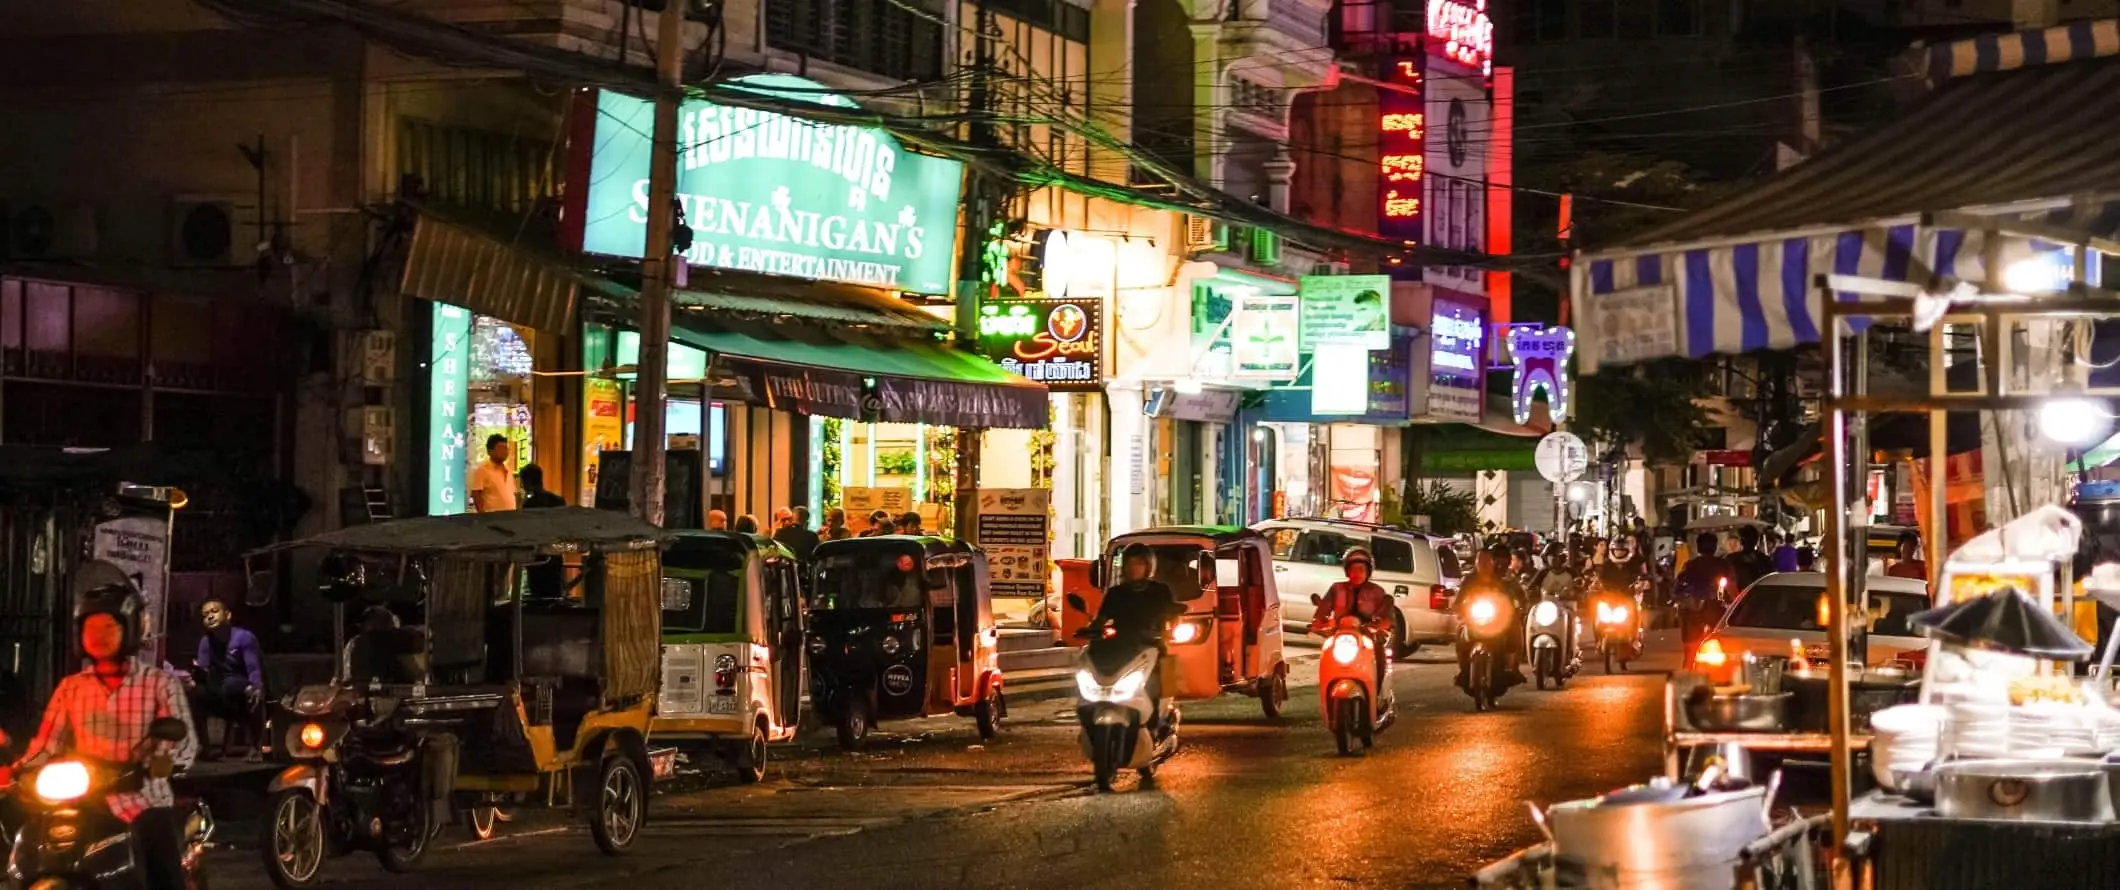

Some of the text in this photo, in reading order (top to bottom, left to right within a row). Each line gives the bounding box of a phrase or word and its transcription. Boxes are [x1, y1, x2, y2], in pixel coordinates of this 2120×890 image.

[628, 178, 924, 259] SENANIGAN'S
[718, 245, 736, 268] &
[737, 247, 900, 286] ENTERTAINMENT
[1013, 331, 1095, 358] Seoul
[440, 332, 457, 517] SHENANIG
